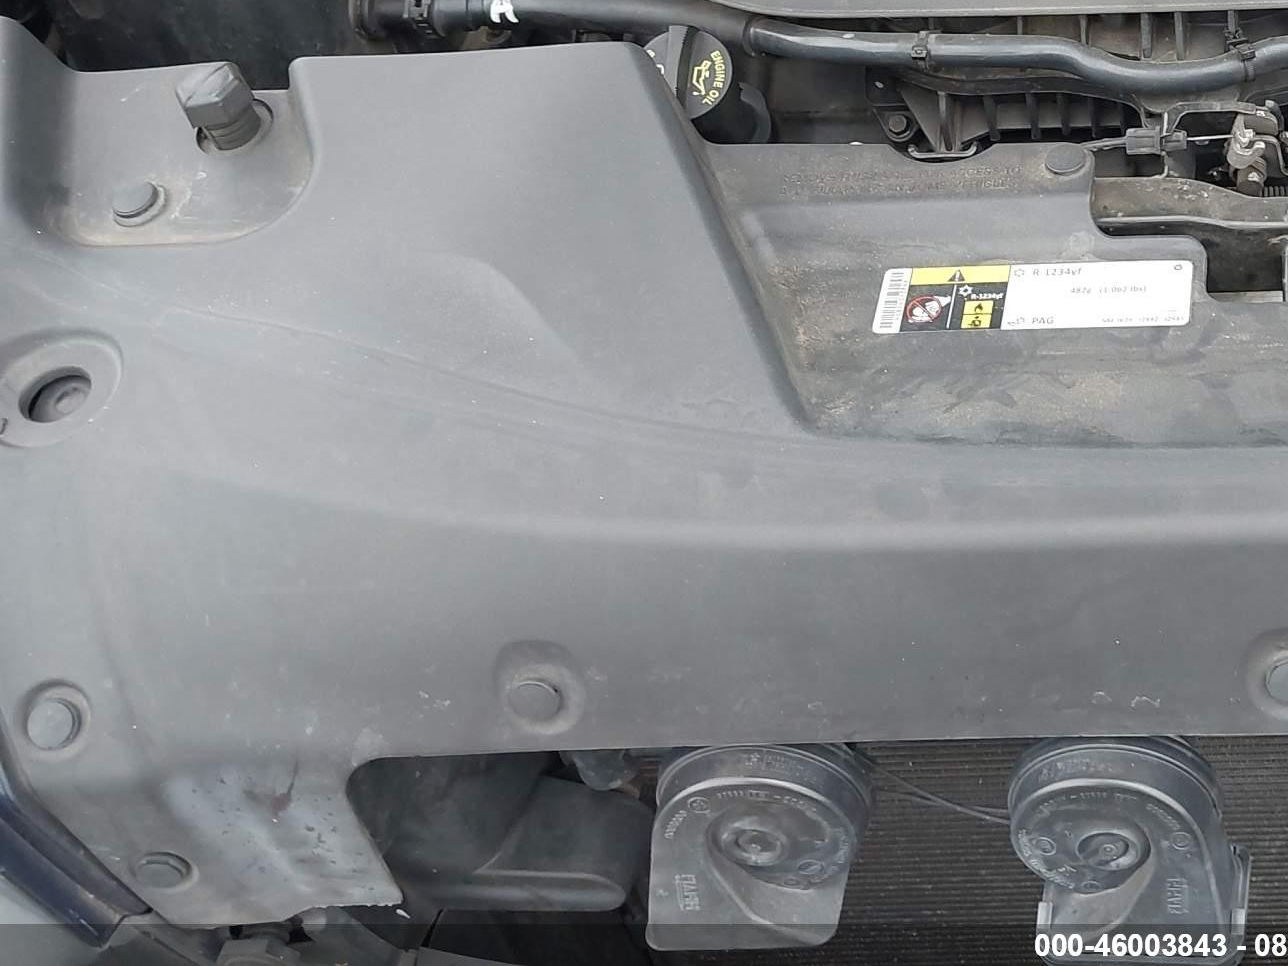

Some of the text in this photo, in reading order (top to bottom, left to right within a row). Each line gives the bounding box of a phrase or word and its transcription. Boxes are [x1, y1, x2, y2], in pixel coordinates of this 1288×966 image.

[701, 49, 727, 106] ENGINE OIL
[1031, 316, 1055, 325] PAG
